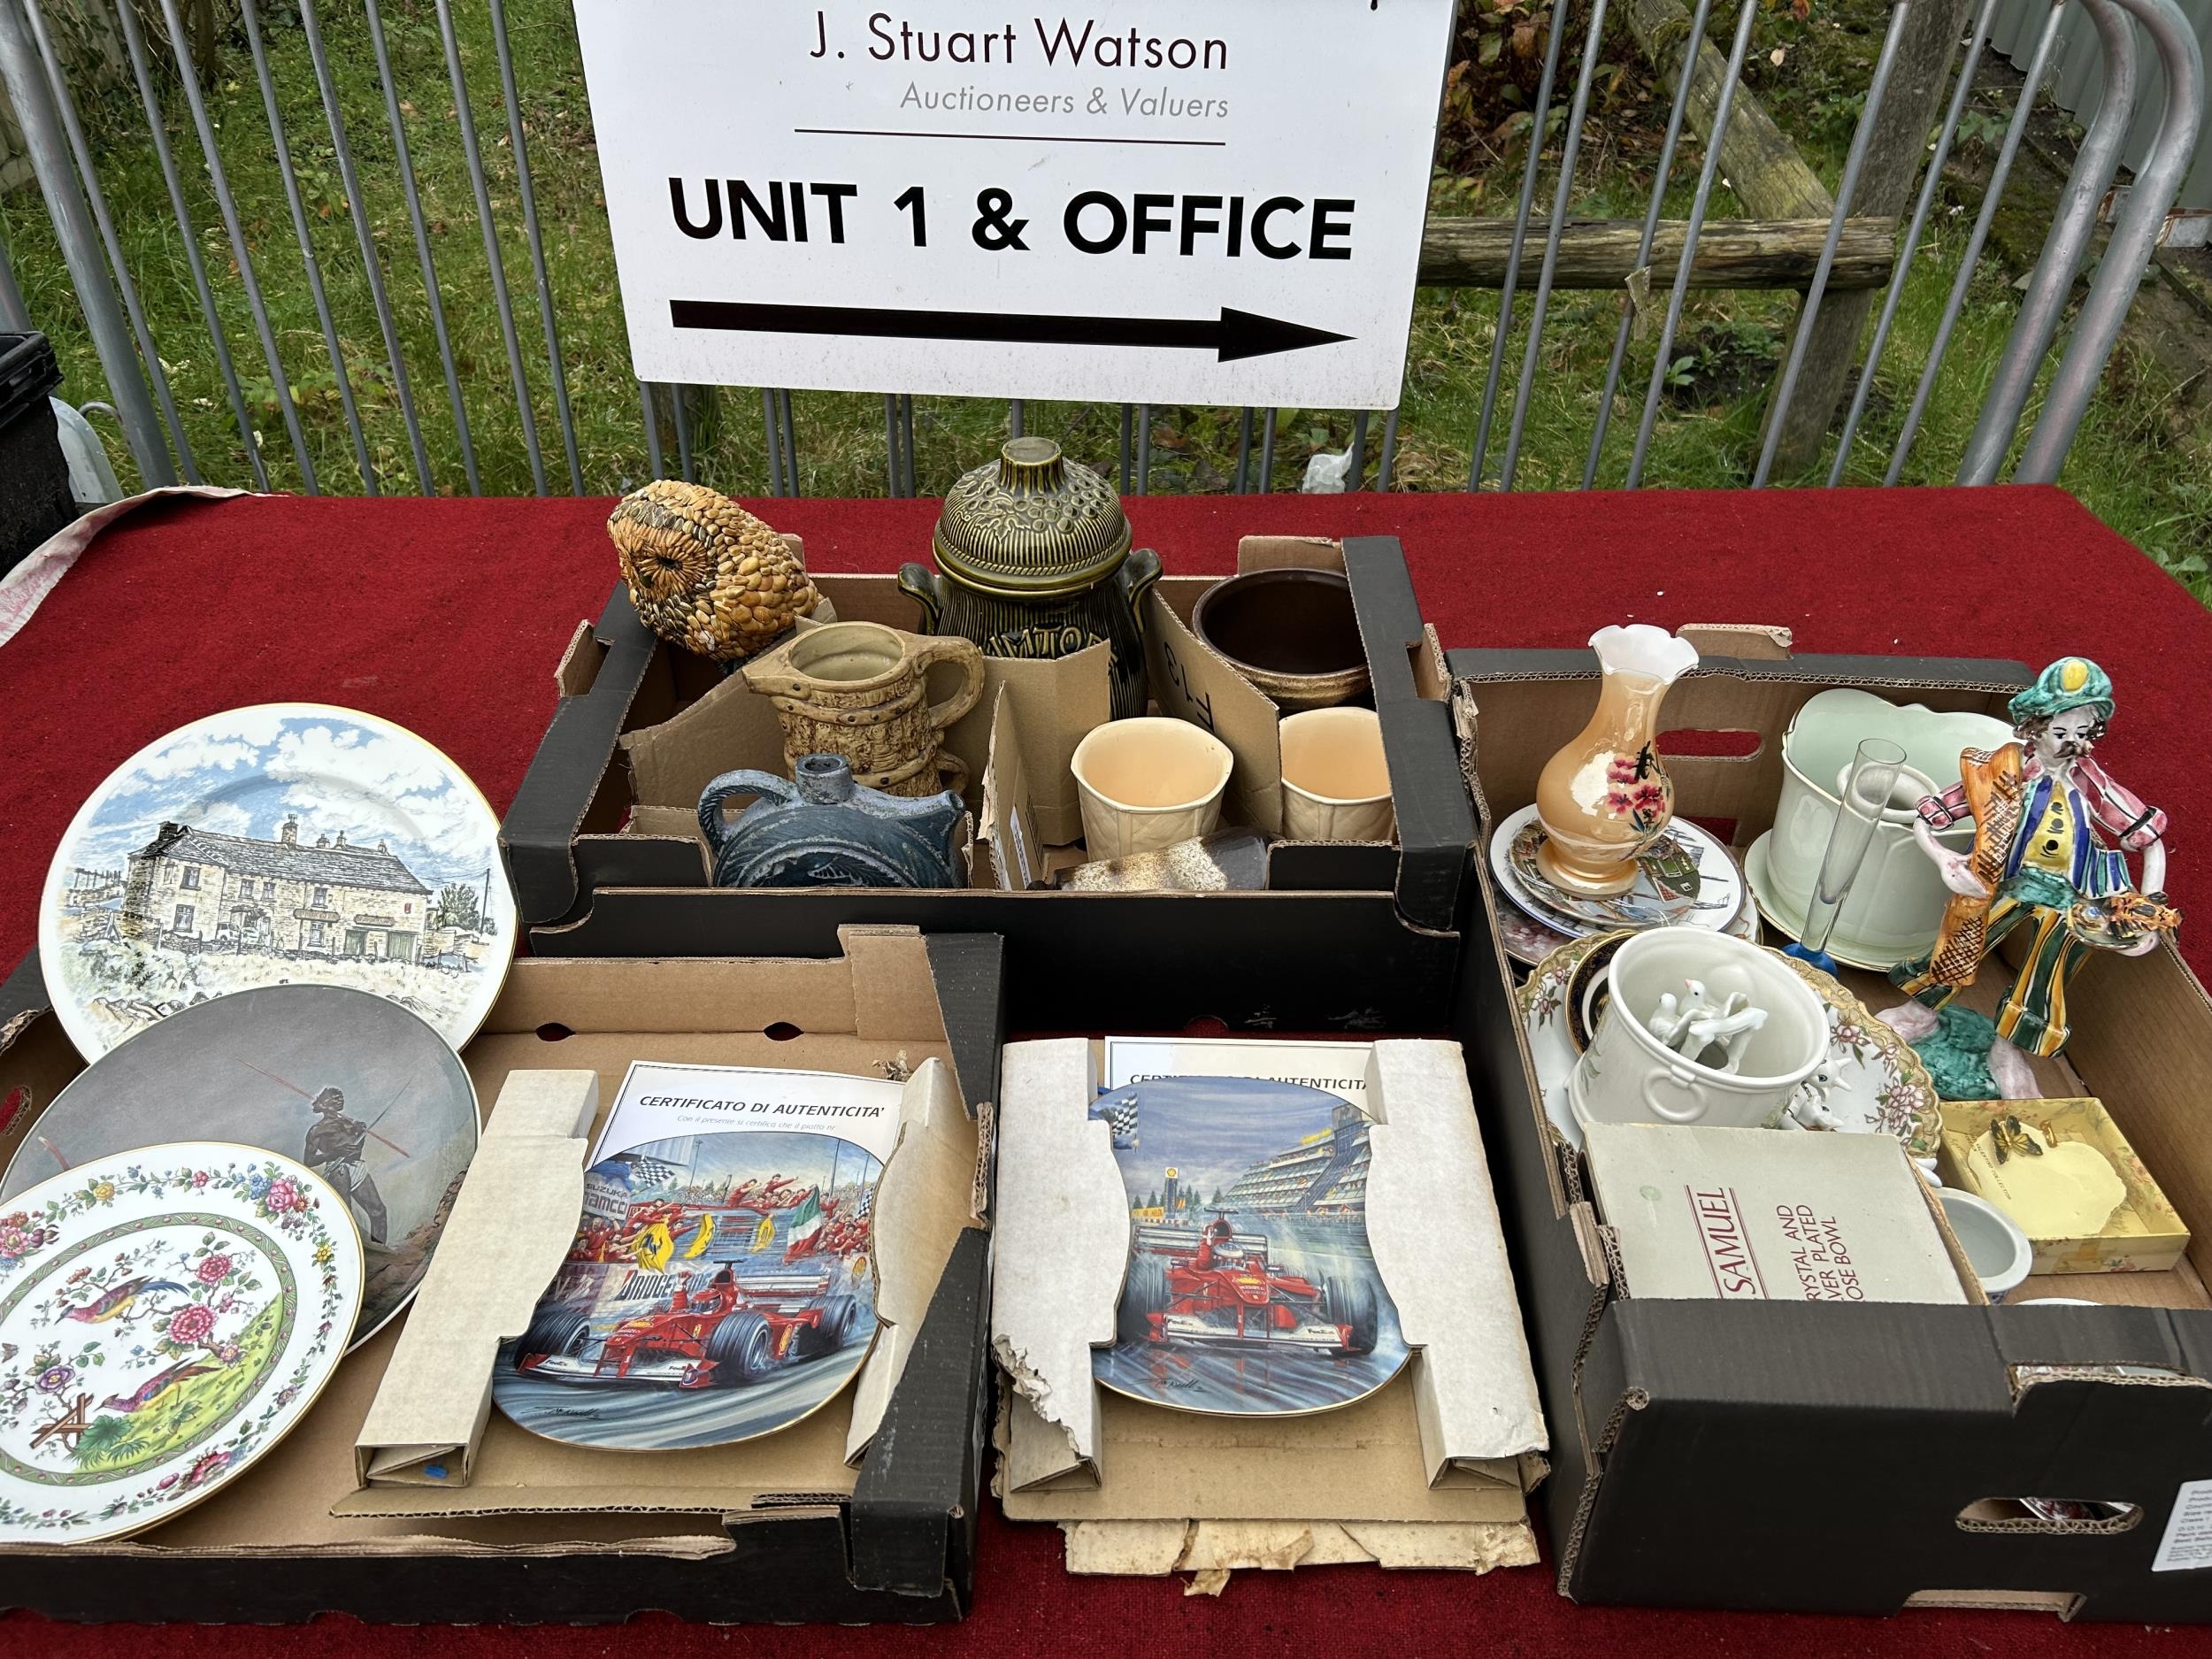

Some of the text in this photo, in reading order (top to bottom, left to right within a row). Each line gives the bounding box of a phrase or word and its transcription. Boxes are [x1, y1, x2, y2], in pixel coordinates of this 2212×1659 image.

[810, 11, 1227, 70] J. Stuart Watson
[900, 81, 1229, 118] Auctioneers & Valuers
[668, 177, 1356, 260] UNIT 1 & OFFICE
[639, 1095, 746, 1112] CERTIFICATO
[750, 1102, 772, 1114] DI
[1696, 1187, 1756, 1295] SAMUEL
[1776, 1204, 1821, 1302] RYSTAL AND
[1795, 1204, 1830, 1263] PLATED
[1819, 1216, 1865, 1302] OSE BOWL
